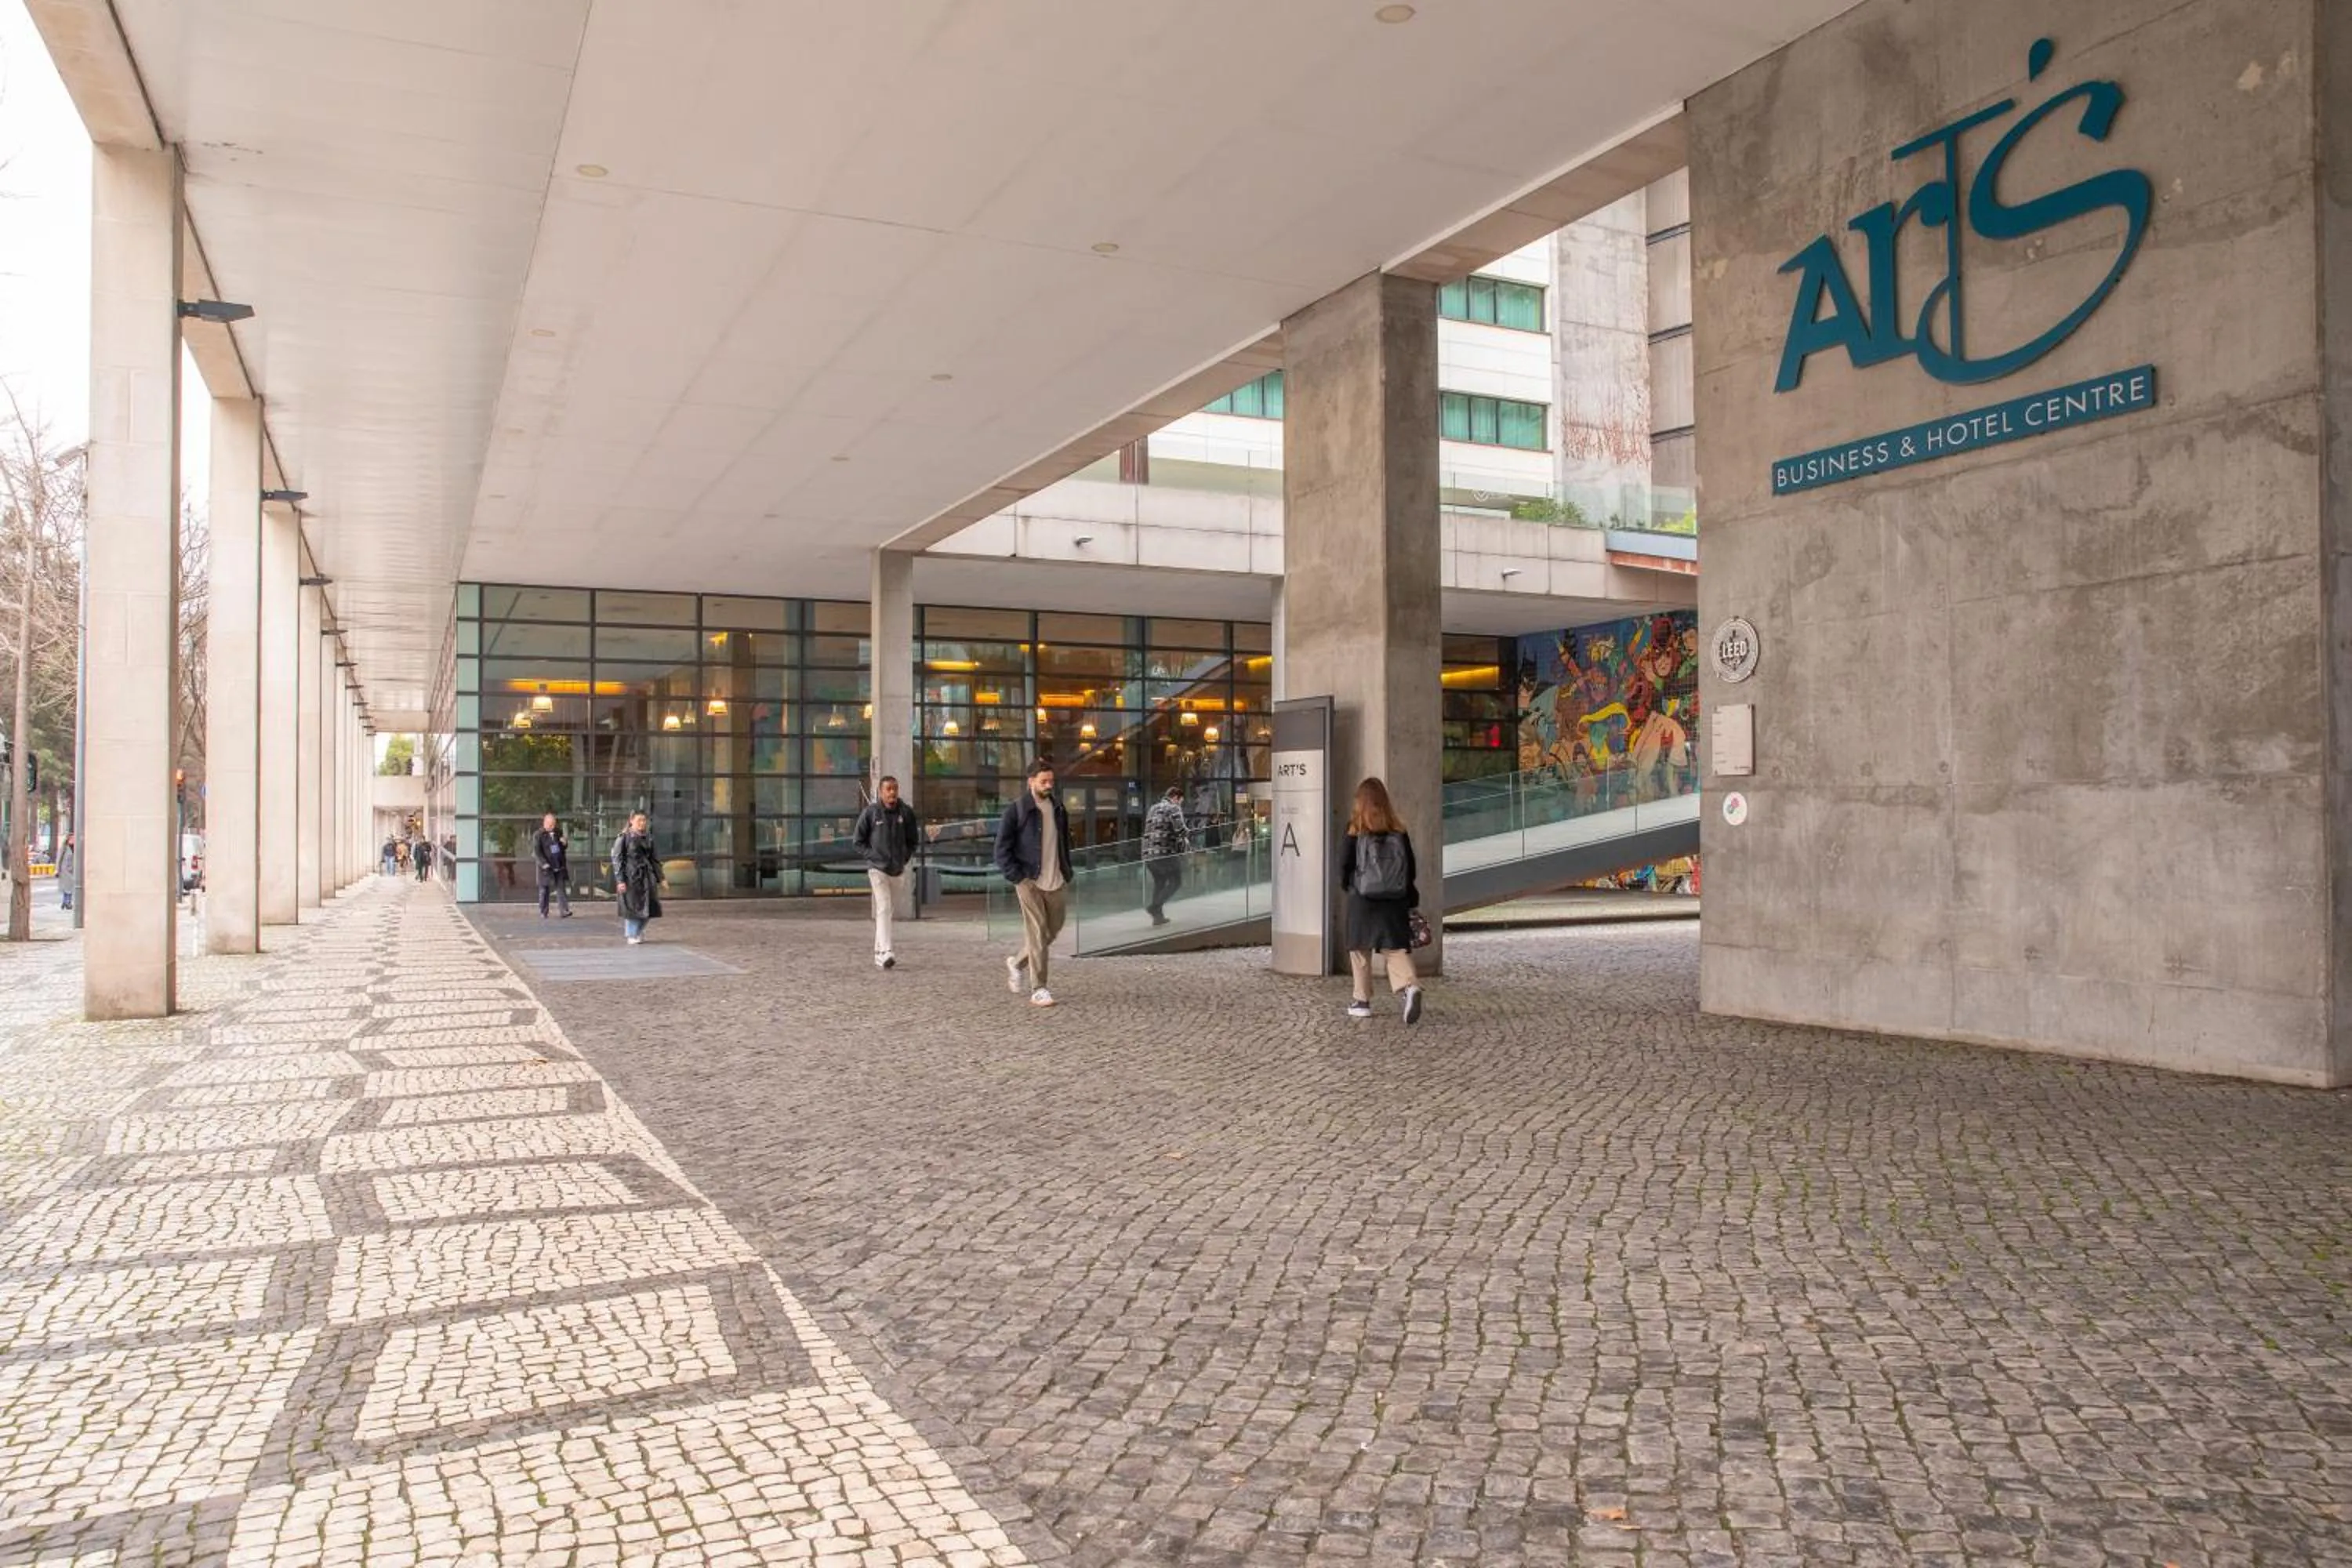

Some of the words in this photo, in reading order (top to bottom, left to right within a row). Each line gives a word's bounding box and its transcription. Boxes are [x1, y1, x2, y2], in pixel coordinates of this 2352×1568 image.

[1777, 441, 1889, 487] BUSINESS
[1900, 436, 1916, 457] &
[1927, 411, 2013, 452] HOTEL
[2025, 376, 2145, 426] CENTRE
[1278, 764, 1307, 777] ART'S
[1280, 822, 1301, 857] A
